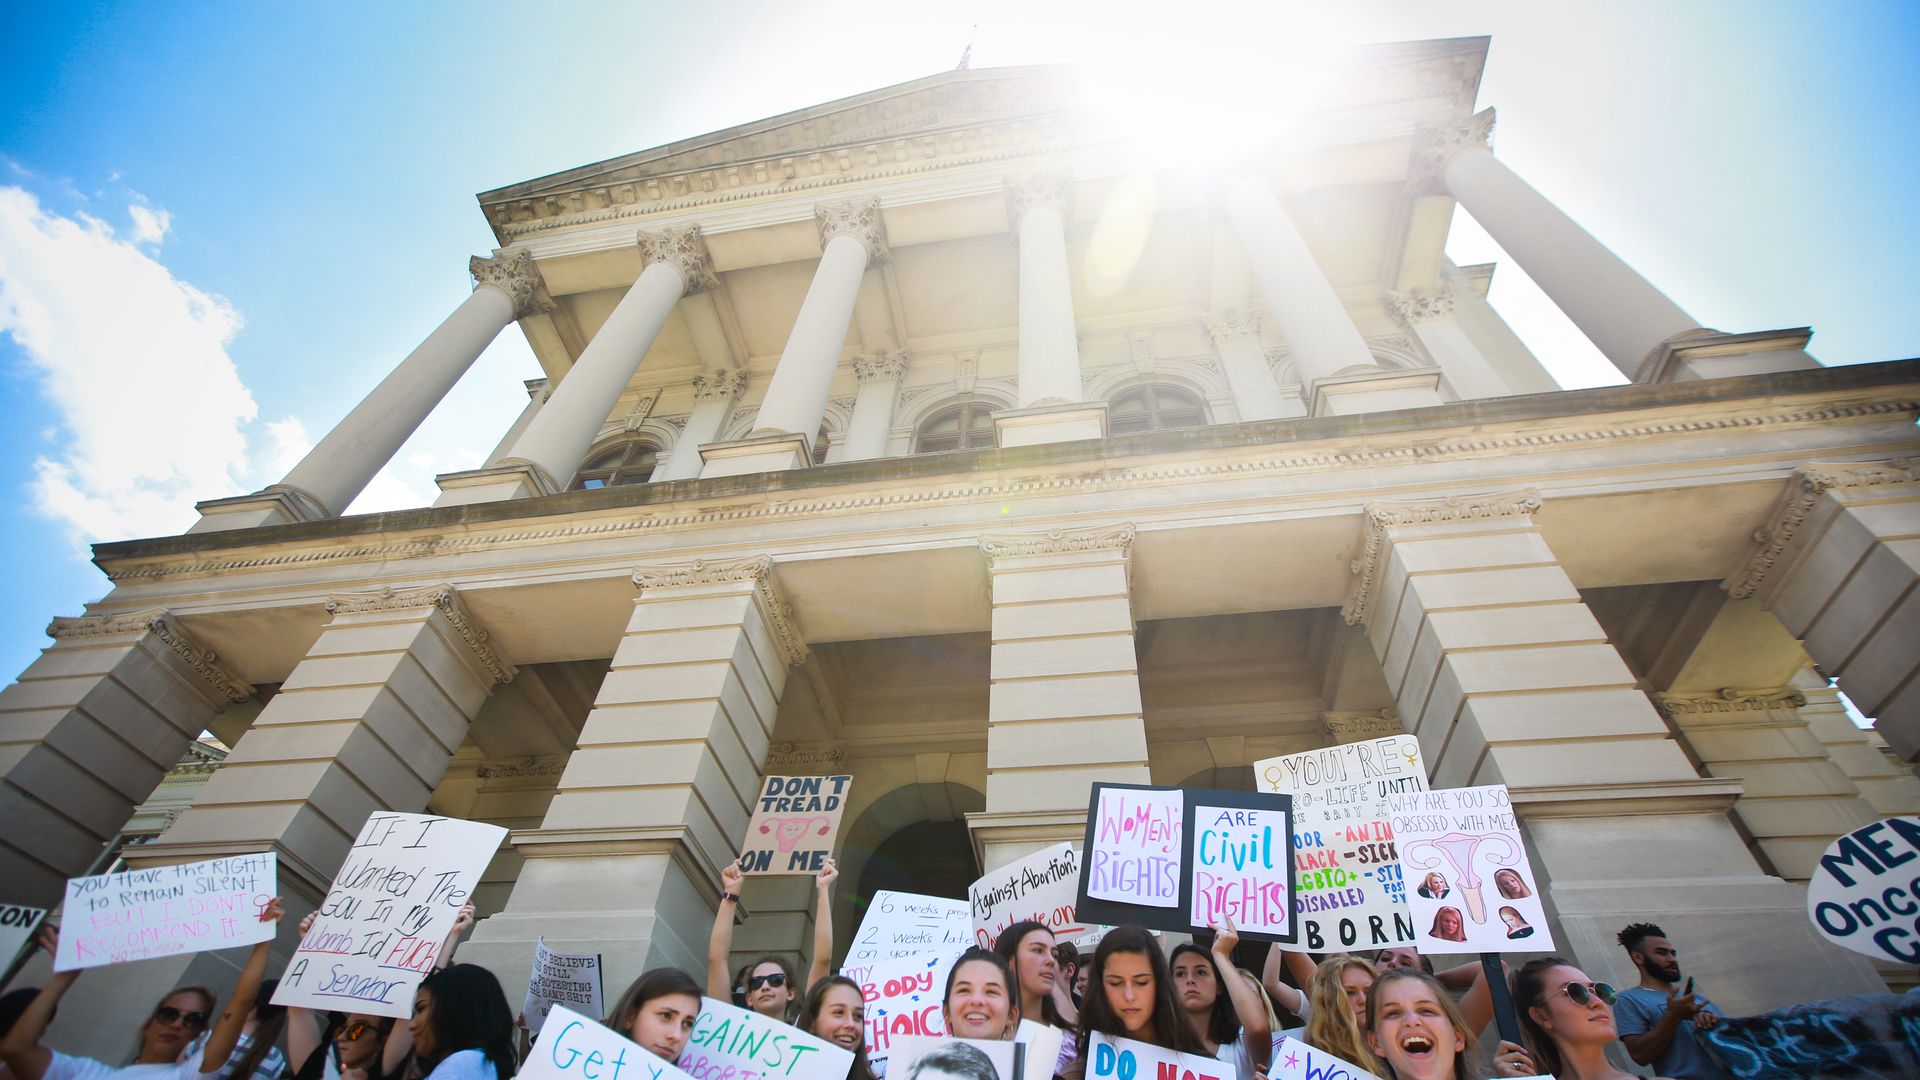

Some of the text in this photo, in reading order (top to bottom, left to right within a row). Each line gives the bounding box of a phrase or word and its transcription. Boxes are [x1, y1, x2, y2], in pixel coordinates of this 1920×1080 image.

[1283, 739, 1401, 789] YOU'RE
[766, 776, 850, 796] DON'T
[1292, 781, 1371, 811] RO-LIFE"
[761, 796, 839, 812] TREAD
[1388, 789, 1510, 812] WHY ARE YOU SO
[1214, 811, 1258, 827] ARE
[1324, 806, 1362, 820] BABY
[1393, 813, 1515, 833] OBSESSED WITH ME?
[353, 816, 448, 849] IF I
[1293, 831, 1324, 849] OOR
[1200, 826, 1273, 871] Civil
[1296, 850, 1339, 870] LACK
[740, 850, 828, 872] ON ME
[71, 877, 110, 898] YOU
[336, 854, 467, 907] Wanted The
[972, 849, 1077, 920] Against Abortion?
[91, 906, 145, 930] BUT
[161, 902, 180, 921] I
[363, 899, 393, 923] In
[1053, 905, 1076, 926] on
[301, 924, 353, 954] Womb
[861, 927, 878, 944] 2
[1305, 912, 1415, 949] BORN
[549, 954, 595, 968] BELIEVE
[857, 950, 877, 959] on
[285, 958, 406, 1000] A Senator
[543, 964, 570, 979] STILL
[538, 975, 592, 992] PROTESTING
[861, 971, 932, 1003] BODY
[542, 988, 565, 1001] SAME
[567, 991, 592, 1004] SHIT
[864, 1006, 953, 1054] HOIC
[553, 1021, 626, 1080] Get
[690, 1012, 820, 1076] GAINST
[1095, 1043, 1136, 1080] DO
